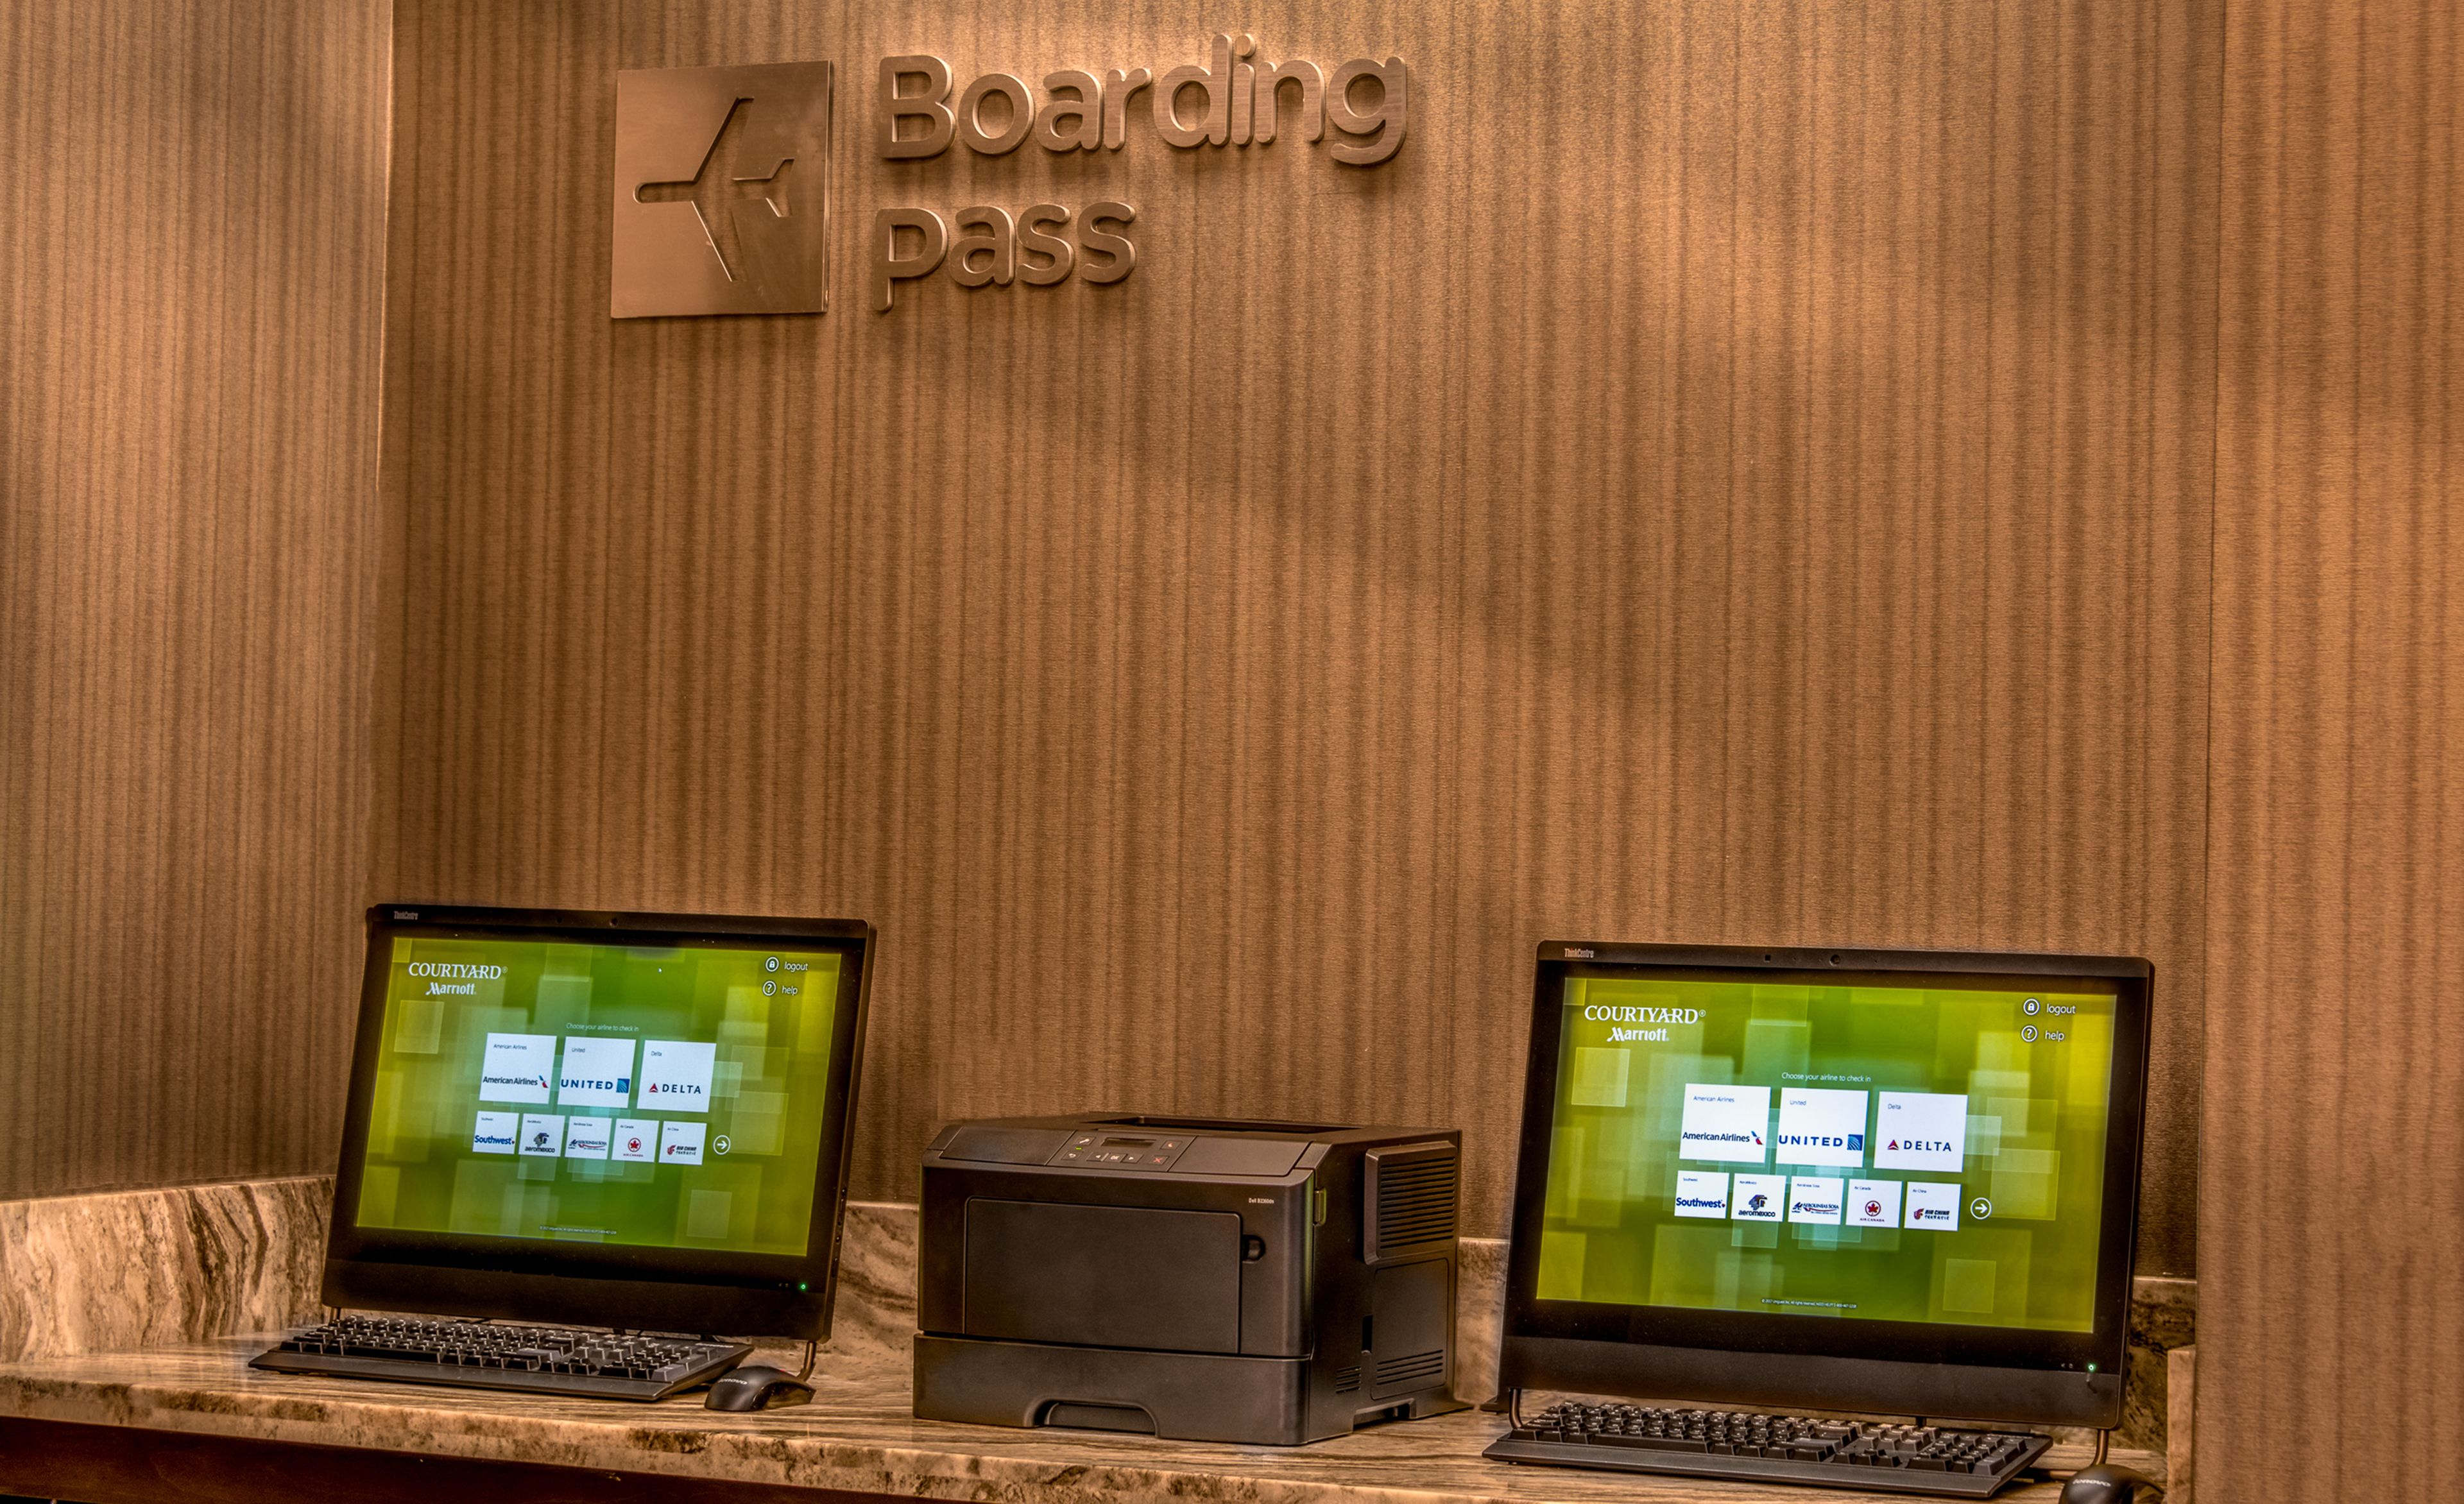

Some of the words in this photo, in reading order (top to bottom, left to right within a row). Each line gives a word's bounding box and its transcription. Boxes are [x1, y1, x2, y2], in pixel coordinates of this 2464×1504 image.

[877, 33, 1408, 166] Boarding
[872, 201, 1138, 312] pass
[784, 961, 809, 973] logout
[425, 982, 476, 995] Marriott
[782, 985, 798, 996] help
[2046, 1003, 2076, 1015] logout
[566, 1022, 585, 1030] Choose
[1607, 1027, 1669, 1042] Marriott
[2045, 1029, 2065, 1042] help
[483, 1075, 513, 1084] American
[513, 1077, 538, 1085] Airlines
[1781, 1072, 1804, 1081] Choose
[561, 1079, 613, 1090] UNITED
[662, 1083, 701, 1095] DELTA
[475, 1134, 512, 1145] Southwest
[1682, 1131, 1720, 1141] American
[1720, 1132, 1750, 1142] Airlines
[1779, 1135, 1843, 1147] UNITED
[1904, 1140, 1952, 1152] DELTA
[1676, 1197, 1722, 1208] Southwest
